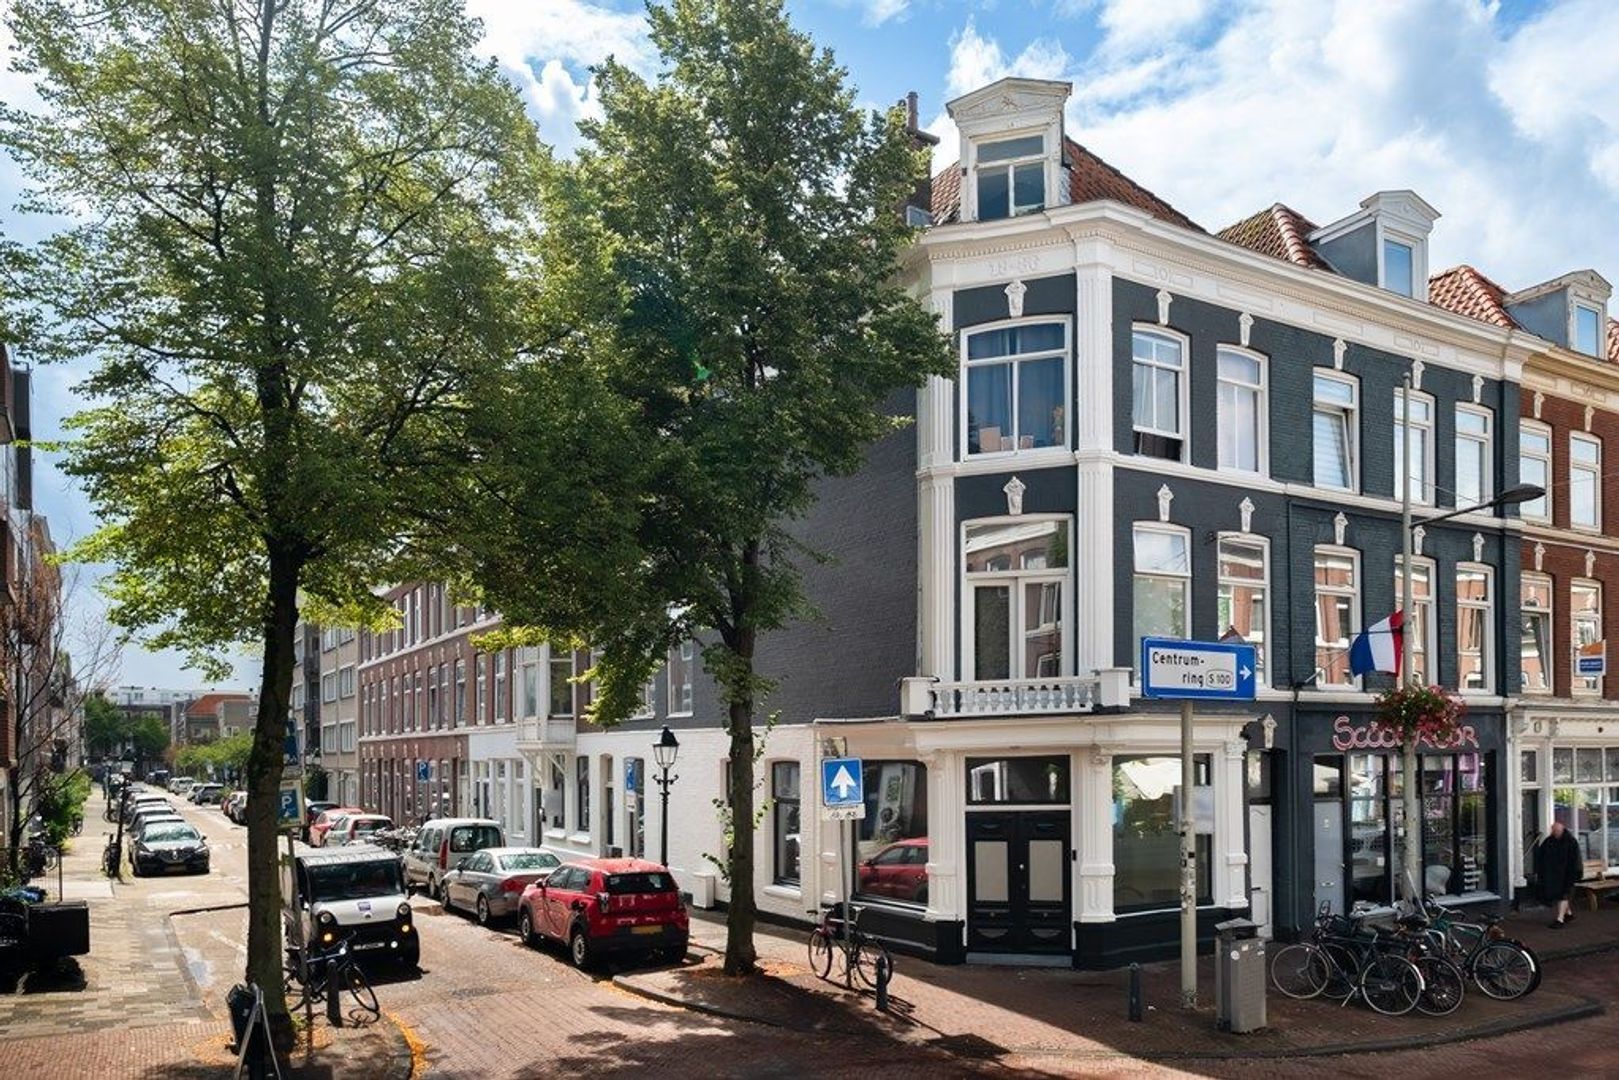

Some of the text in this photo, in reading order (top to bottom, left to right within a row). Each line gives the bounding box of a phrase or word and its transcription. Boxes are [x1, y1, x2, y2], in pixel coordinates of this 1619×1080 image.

[1152, 651, 1205, 666] Centrum-
[1182, 671, 1204, 687] ring
[1209, 673, 1230, 685] S 100
